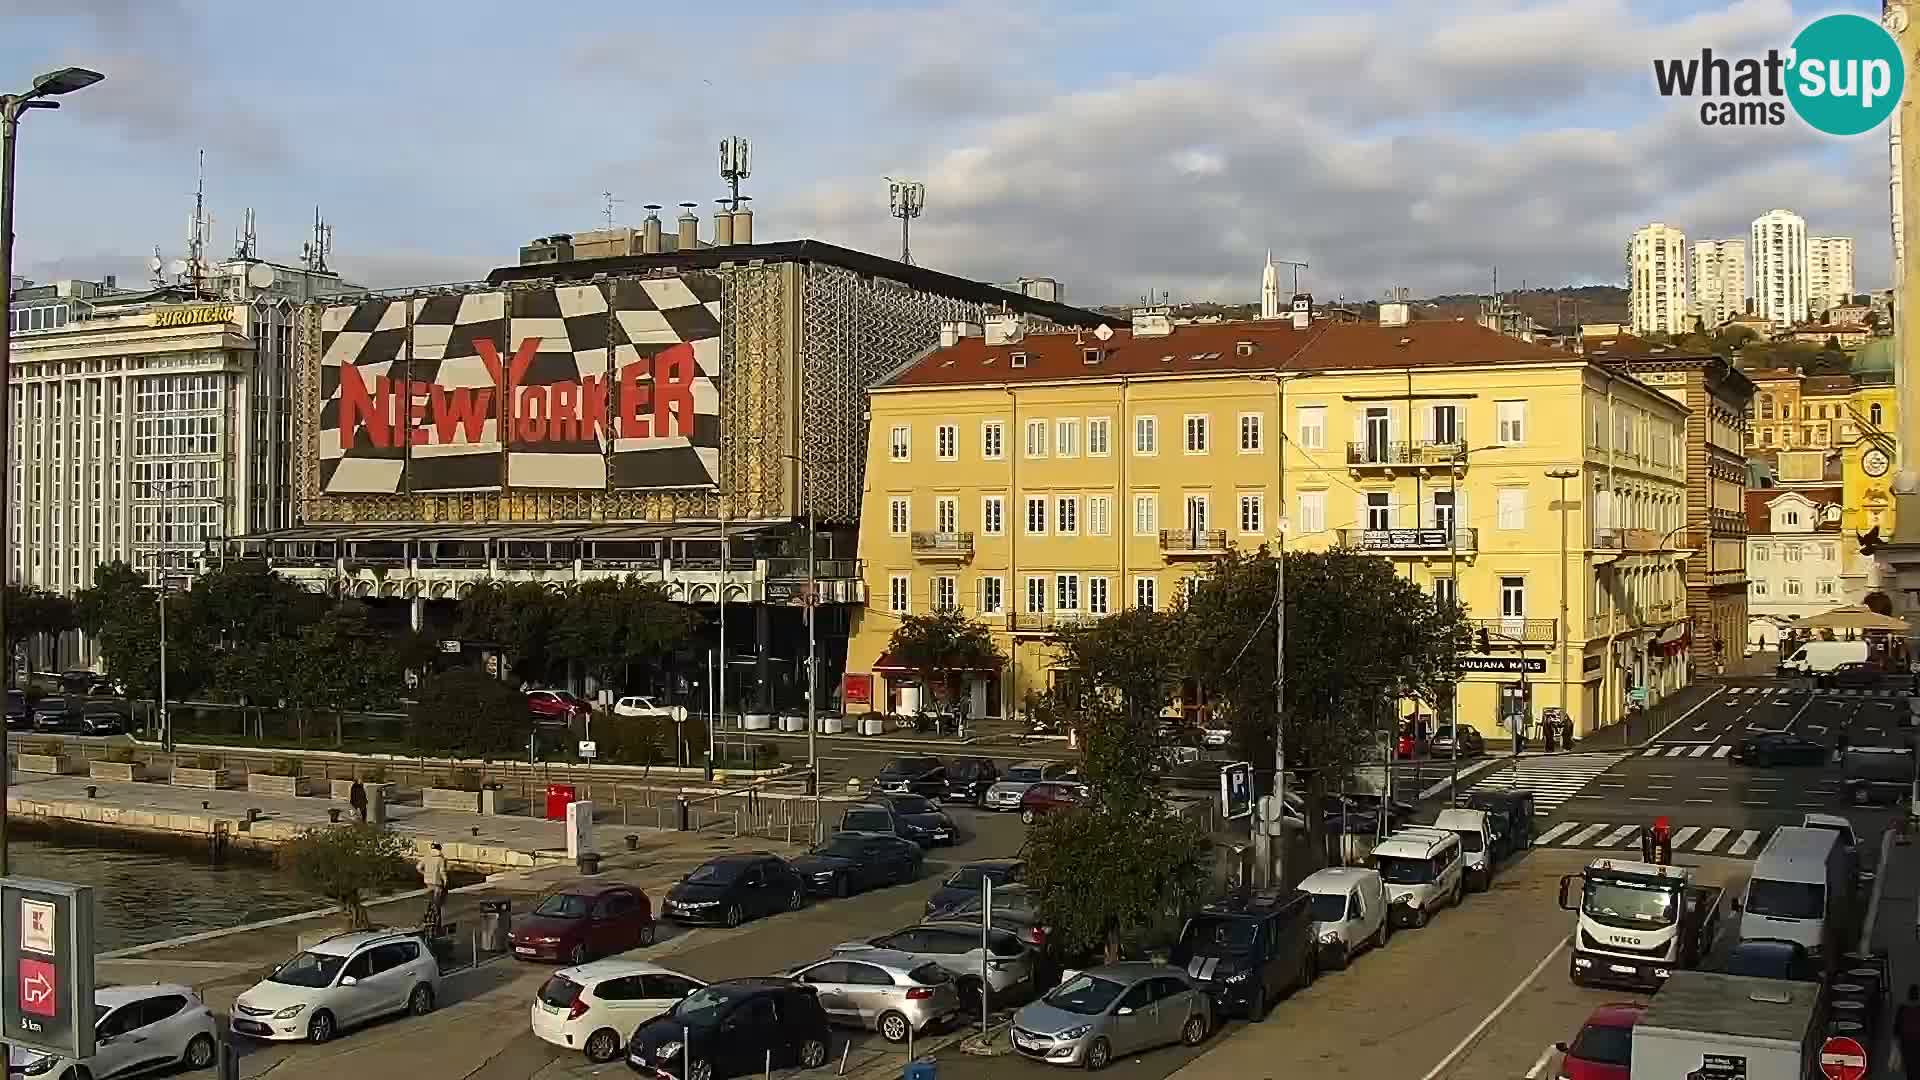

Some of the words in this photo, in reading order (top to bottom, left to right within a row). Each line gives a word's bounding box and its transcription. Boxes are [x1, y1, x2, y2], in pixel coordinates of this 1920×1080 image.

[1459, 660, 1505, 670] JULIANA
[1509, 661, 1541, 671] NAILS
[1609, 935, 1641, 945] IVECO
[21, 1018, 28, 1029] 5
[28, 1019, 42, 1033] km
